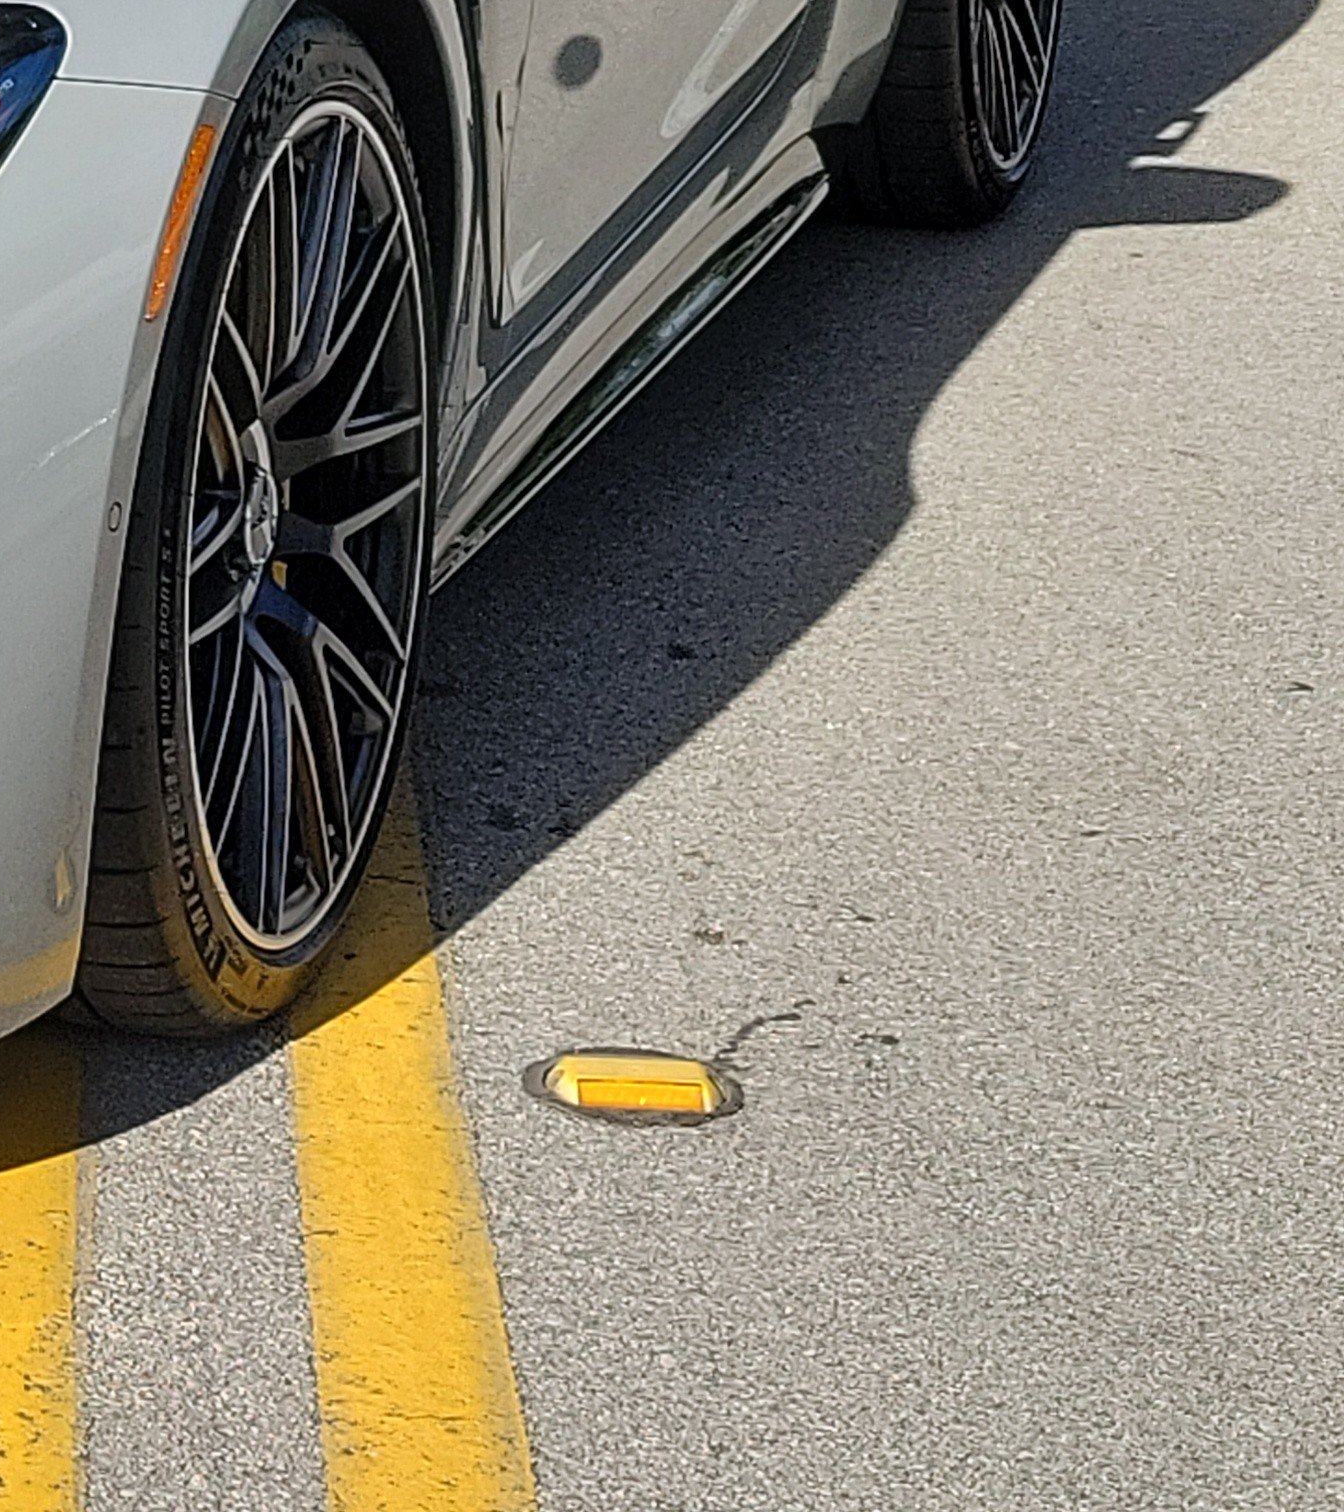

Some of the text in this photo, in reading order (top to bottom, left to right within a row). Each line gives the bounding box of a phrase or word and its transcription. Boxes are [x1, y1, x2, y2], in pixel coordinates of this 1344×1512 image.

[159, 570, 173, 651] SPORT
[159, 657, 173, 725] PILOT
[161, 737, 211, 937] MICHELIN
